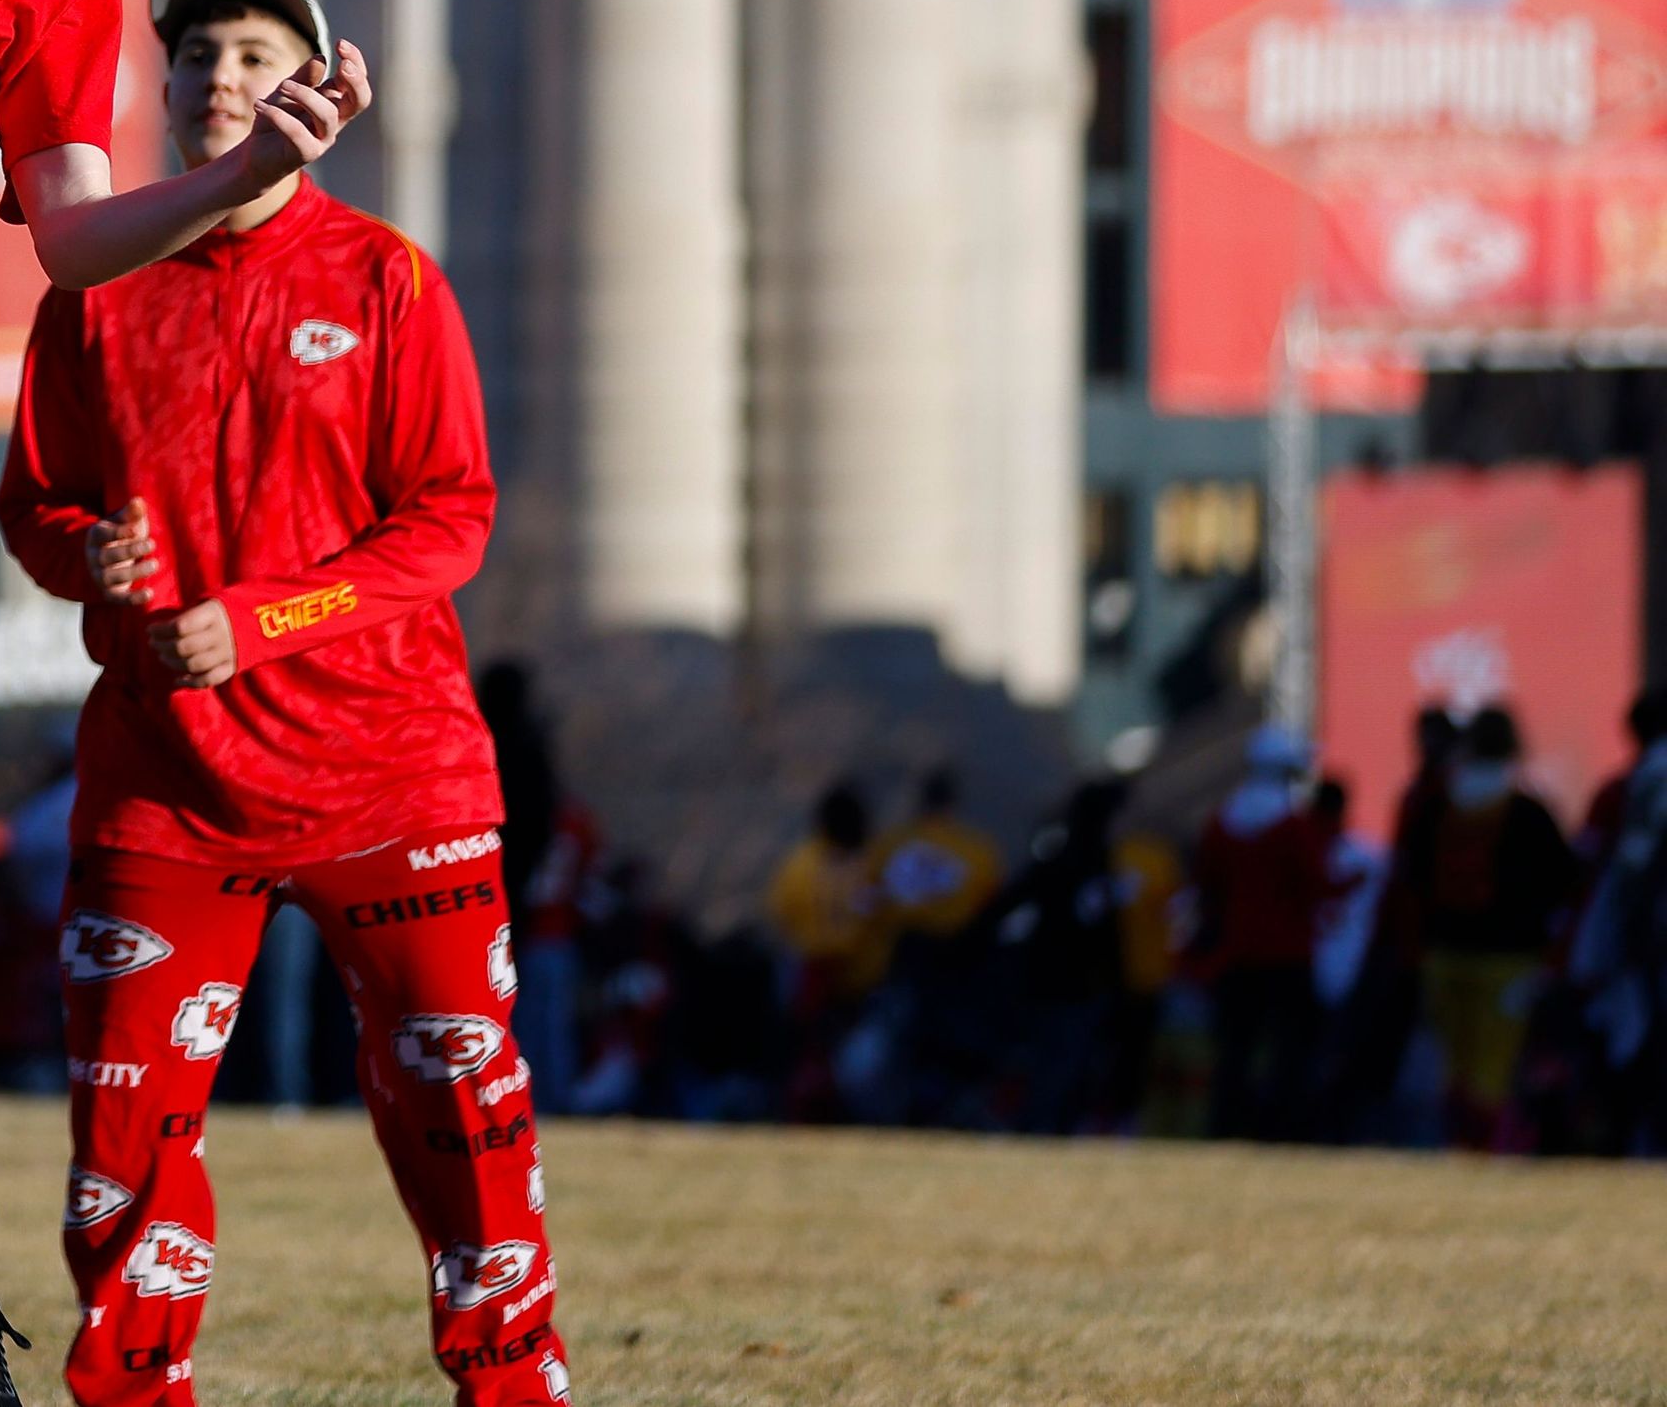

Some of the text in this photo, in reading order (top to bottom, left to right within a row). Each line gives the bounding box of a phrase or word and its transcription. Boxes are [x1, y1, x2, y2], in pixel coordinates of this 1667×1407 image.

[259, 584, 358, 639] CHIEFS
[345, 880, 495, 929] CHIEFS
[88, 1061, 150, 1088] CITY
